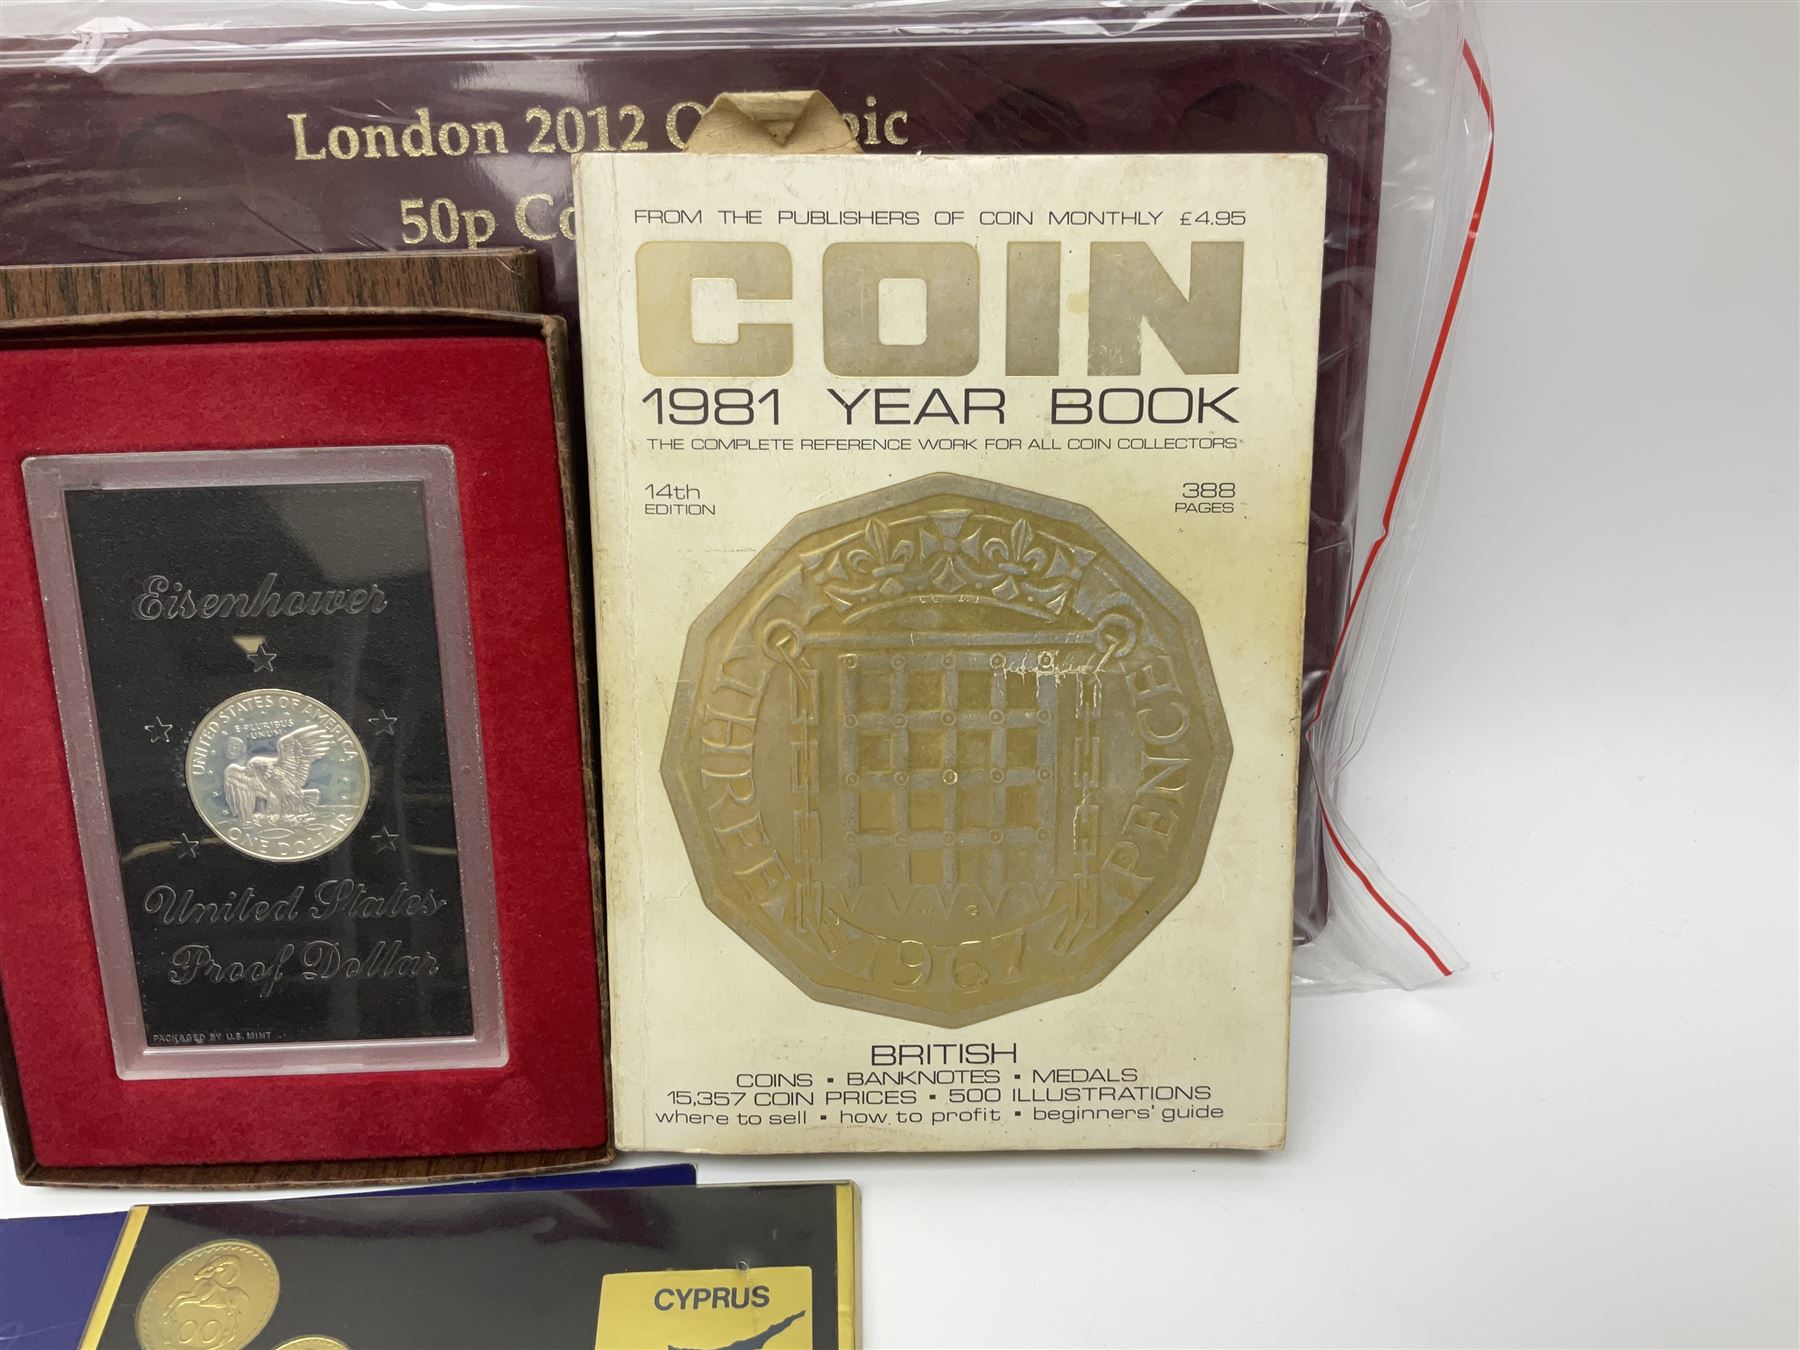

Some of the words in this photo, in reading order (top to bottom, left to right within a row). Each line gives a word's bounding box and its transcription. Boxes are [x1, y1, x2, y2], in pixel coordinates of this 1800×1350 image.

[287, 106, 509, 161] London
[525, 106, 649, 153] 2012
[400, 197, 496, 249] 50p
[635, 210, 702, 225] FROM
[718, 210, 762, 225] THE
[778, 210, 920, 226] PUBLISHERS
[934, 211, 965, 226] OF
[979, 210, 1034, 226] COIN
[1048, 210, 1163, 226] MONTHLY
[1179, 210, 1247, 226] £4.95
[635, 240, 1244, 377] COIN
[641, 387, 780, 426] 1981
[826, 387, 1006, 425] YEAR
[1050, 386, 1240, 425] BOOK
[646, 438, 685, 451] THE
[690, 438, 794, 451] COMPLETE
[800, 438, 912, 451] REFERENCE
[917, 438, 979, 451] WORK
[984, 438, 1023, 451] FOR
[1027, 438, 1063, 450] ALL
[1067, 438, 1112, 450] COIN
[1117, 437, 1239, 450] COLLECTORS
[644, 483, 701, 500] 14th
[1181, 482, 1236, 499] 388
[644, 503, 716, 516] EDITION
[1174, 502, 1235, 514] PAGES
[133, 572, 388, 620] Eisenhower
[192, 721, 221, 776] UNITED
[218, 695, 275, 725] STATES
[278, 696, 301, 710] OF
[301, 703, 361, 761] AMERICA
[700, 655, 794, 892] THREE
[1102, 652, 1192, 887] PENCE
[227, 826, 269, 854] ONE
[144, 885, 304, 926] United
[308, 877, 447, 920] States
[167, 943, 296, 998] Proof
[301, 939, 441, 980] Dollar
[152, 1033, 206, 1043] PACKAGED
[209, 1033, 222, 1041] BY
[246, 1031, 272, 1040] MINT
[871, 1042, 1017, 1066] BRITISH
[736, 1073, 814, 1088] COINS
[846, 1069, 1001, 1086] BANKNOTES
[1032, 1067, 1138, 1084] MEDALS
[667, 1090, 747, 1108] 15,357
[753, 1091, 814, 1107] COIN
[825, 1089, 917, 1105] PRICES
[948, 1087, 1002, 1103] 500
[1012, 1085, 1212, 1102] ILLUSTRATIONS
[655, 1110, 729, 1125] where
[736, 1112, 762, 1126] to
[769, 1110, 807, 1125] sell
[840, 1110, 891, 1126] how
[896, 1110, 923, 1123] to
[931, 1107, 1001, 1126] profit
[1033, 1105, 1155, 1124] beginners'
[1162, 1104, 1224, 1123] guide
[653, 1284, 771, 1312] CYPRUS
